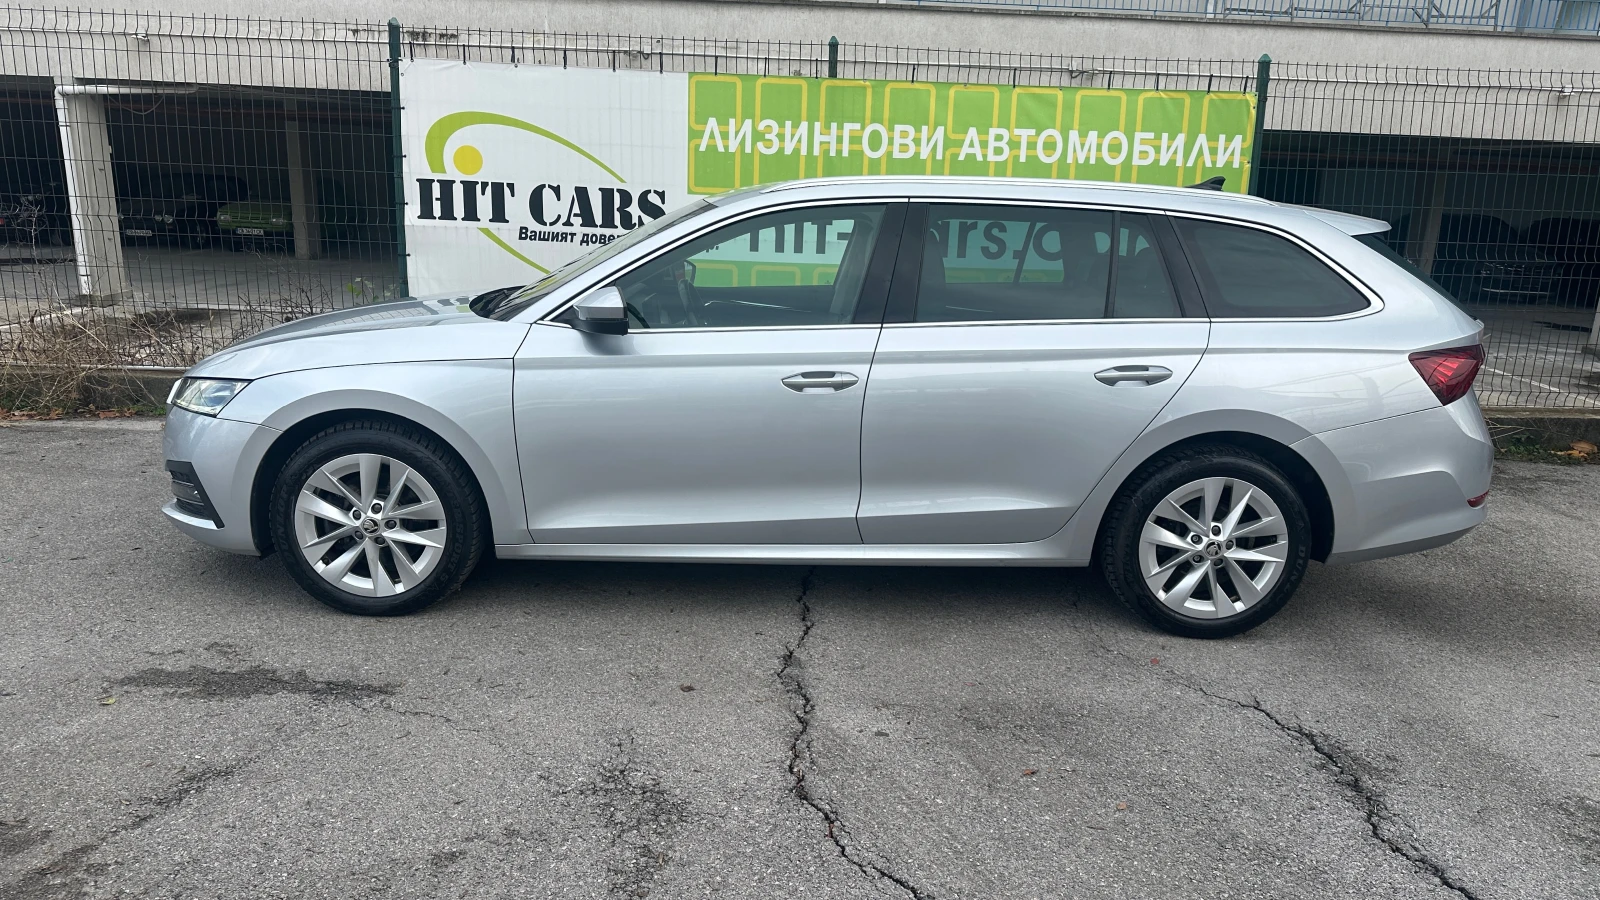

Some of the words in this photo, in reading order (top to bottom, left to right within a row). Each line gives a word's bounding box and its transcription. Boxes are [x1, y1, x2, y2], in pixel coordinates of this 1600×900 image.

[699, 117, 945, 160] ЛИЗИНГОВИ
[958, 127, 1243, 169] АВТОМОБИЛИ
[416, 178, 515, 223] HIT
[528, 183, 667, 231] CARS
[518, 226, 577, 243] Вашият
